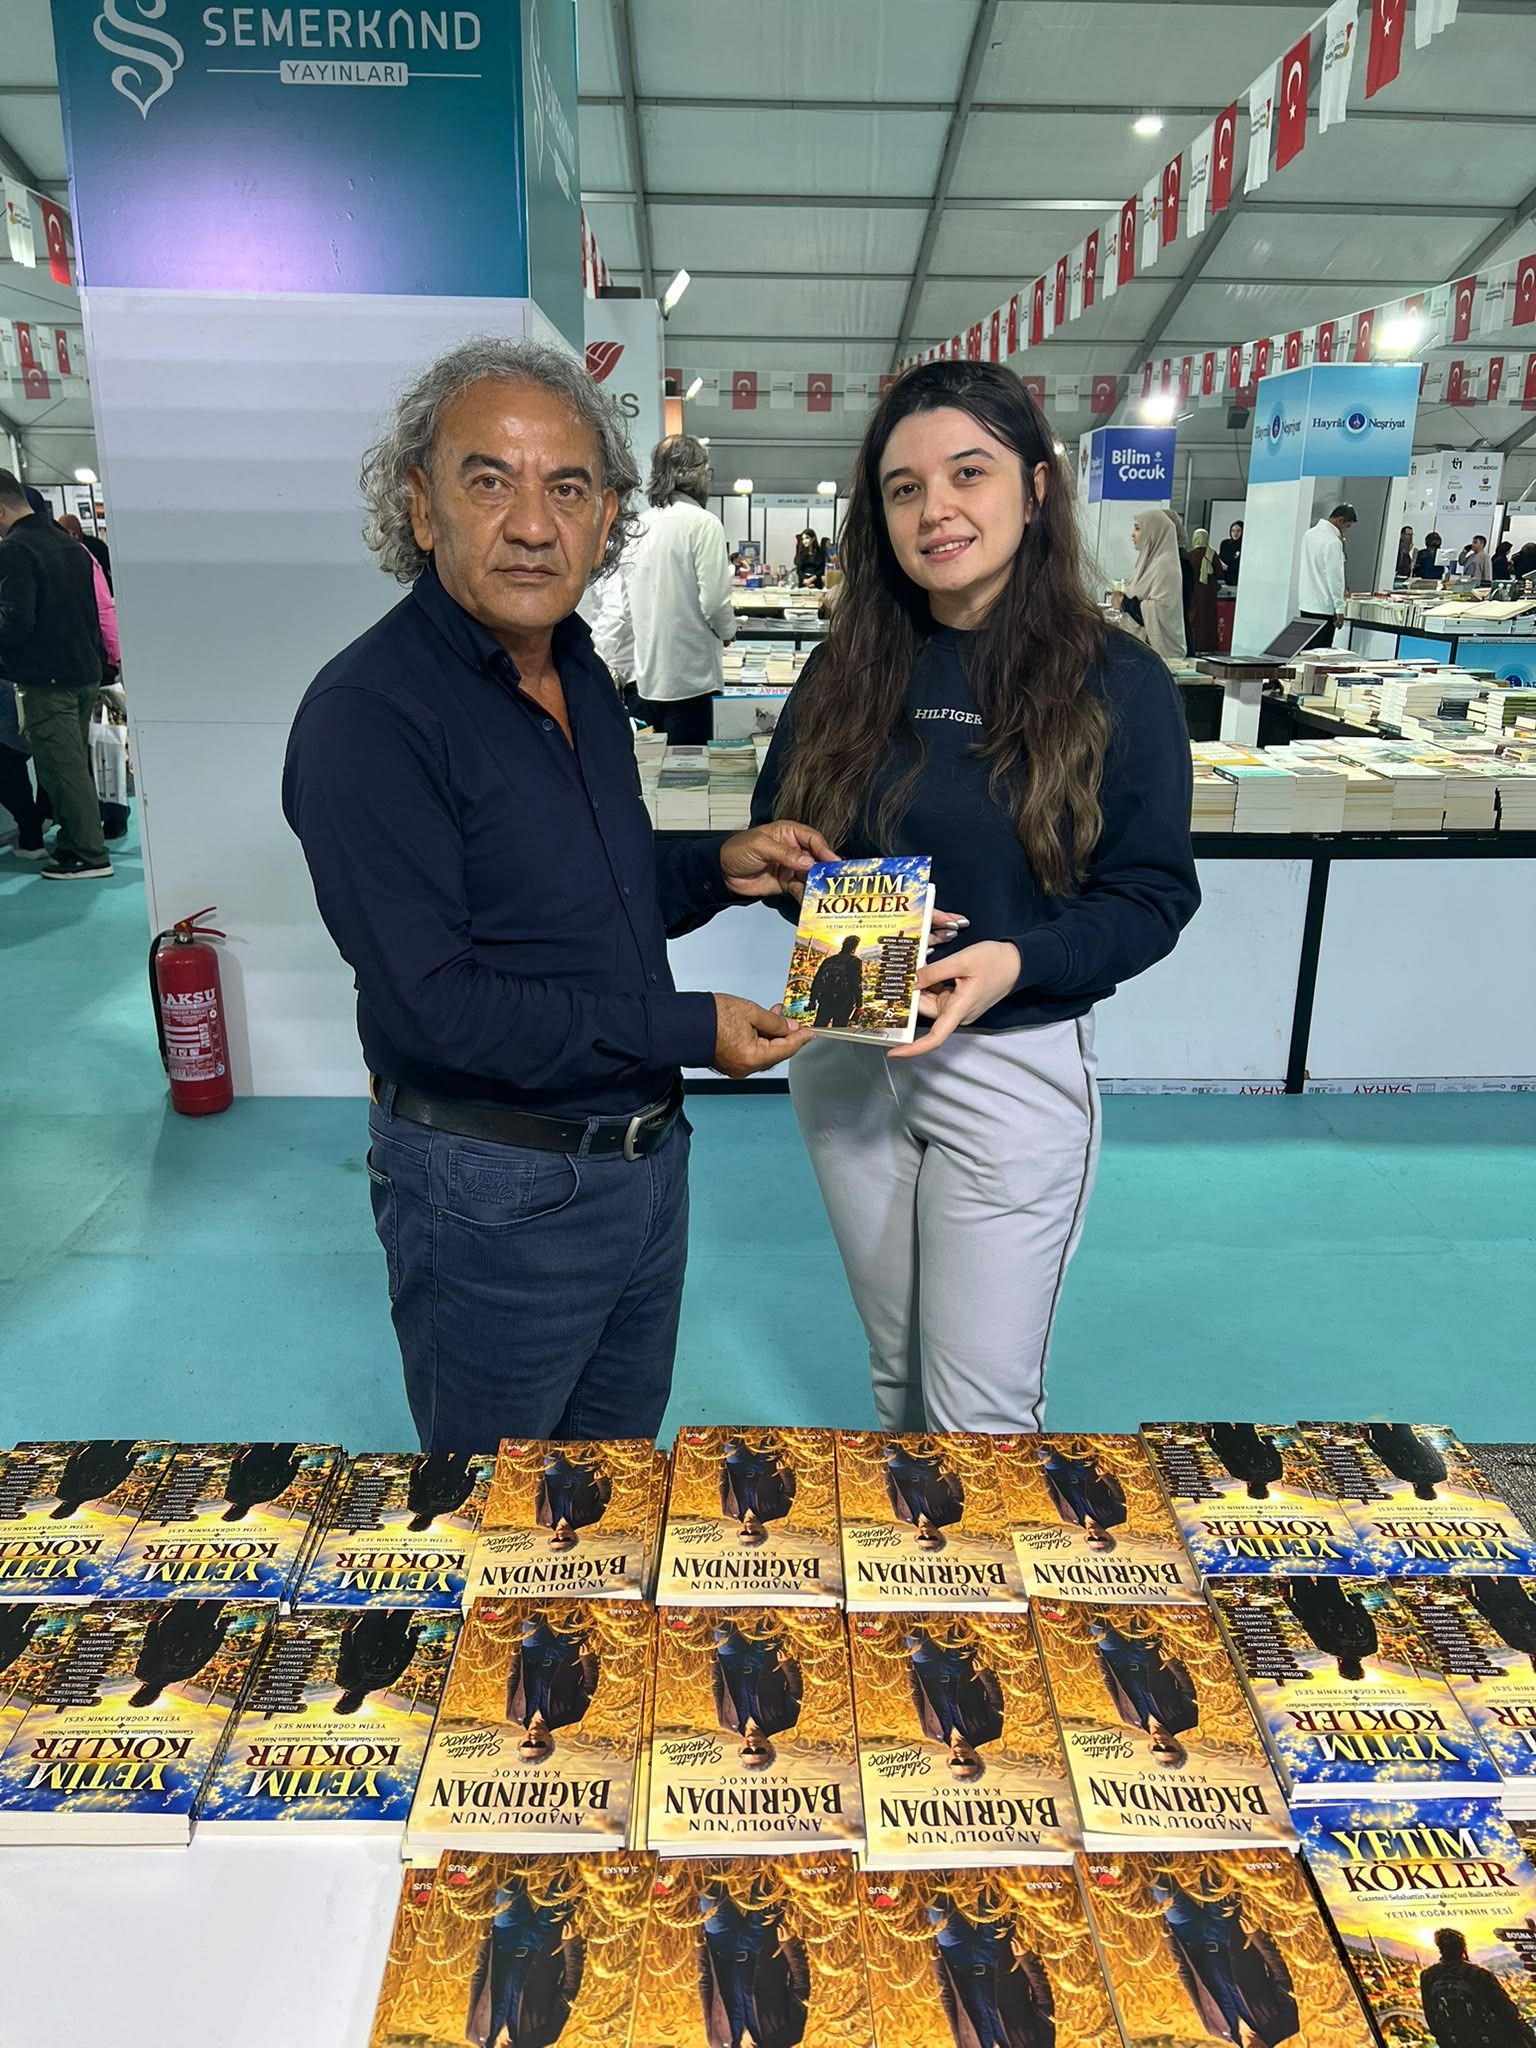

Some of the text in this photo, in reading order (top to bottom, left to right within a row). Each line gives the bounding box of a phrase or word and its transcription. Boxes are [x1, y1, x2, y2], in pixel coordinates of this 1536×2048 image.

[202, 7, 481, 50] SEMERKAND
[287, 63, 403, 83] YAYINLARI
[1369, 418, 1405, 429] Neşriyat
[1112, 449, 1150, 464] Bilim
[1119, 464, 1165, 482] Çocuk
[914, 708, 983, 725] HILFIGER
[826, 872, 906, 896] YETİM
[816, 895, 910, 913] KÖKLER
[166, 988, 215, 1004] AKSU
[1240, 1087, 1287, 1095] ARAY
[671, 1525, 717, 1536] KARAKOÇ
[848, 1526, 894, 1539] KARAKOÇ
[1019, 1530, 1063, 1543] KARAKOÇ
[1200, 1521, 1335, 1540] KÖKLER
[1370, 1522, 1508, 1540] KÖKLER
[483, 1533, 529, 1547] KARAKOÇ
[1220, 1537, 1343, 1560] YETİM
[0, 1540, 105, 1559] KÖKL
[142, 1543, 280, 1561] KÖKLER
[719, 1550, 776, 1558] KARAKOÇ
[901, 1554, 959, 1563] KARAKOÇ
[1396, 1540, 1520, 1563] YETİM
[0, 1558, 80, 1578] YET
[336, 1553, 468, 1572] KÖKLER
[528, 1554, 586, 1564] KARAKOÇ
[1074, 1556, 1132, 1564] KARAKOÇ
[140, 1560, 260, 1584] YETİM
[479, 1554, 627, 1586] BAĞRINDAN
[672, 1557, 820, 1582] BAĞRINDAN
[857, 1561, 1007, 1586] BAĞRINDAN
[1033, 1562, 1183, 1585] BAĞRINDAN
[336, 1570, 451, 1593] YETİM
[497, 1578, 608, 1596] ANADOLU'NUN
[690, 1580, 803, 1590] ANADOLU'NUN
[879, 1586, 991, 1597] ANADOLU'NUN
[1059, 1586, 1168, 1596] ANADOLU'NUN
[1284, 1710, 1447, 1735] KÖKLER
[439, 1729, 499, 1746] KARAKOÇ
[660, 1737, 715, 1754] KARAKOÇ
[1071, 1731, 1122, 1745] KARAKOÇ
[30, 1737, 195, 1763] KÖKLER
[246, 1744, 403, 1770] KÖKLER
[868, 1747, 922, 1766] KARAKOÇ
[1312, 1733, 1459, 1766] YETİM
[24, 1762, 166, 1795] YETİM
[491, 1769, 560, 1778] KARAKOÇ
[719, 1776, 788, 1785] KARAKOÇ
[1138, 1771, 1207, 1783] KARAKOÇ
[243, 1769, 381, 1802] YETİM
[931, 1787, 1000, 1796] KARAKOÇ
[429, 1779, 611, 1811] BAĞRINDAN
[665, 1784, 843, 1819] BAĞRINDAN
[1088, 1777, 1271, 1817] BAĞRINDAN
[450, 1812, 585, 1826] ANADOLU'NUN
[880, 1797, 1061, 1830] BAĞRINDAN
[1120, 1813, 1252, 1832] ANADOLU'NUN
[688, 1818, 823, 1832] ANADOLU'NUN
[907, 1831, 1041, 1845] ANADOLU'NUN
[1330, 1822, 1486, 1860] YETİM
[656, 1874, 674, 1883] EFS
[1090, 1865, 1120, 1874] EFSUS
[1339, 1861, 1519, 1892] KÖKLER
[868, 1885, 898, 1894] EFSUS
[1384, 1906, 1513, 1919] YETİM COĞRAFYANIN SESİ
